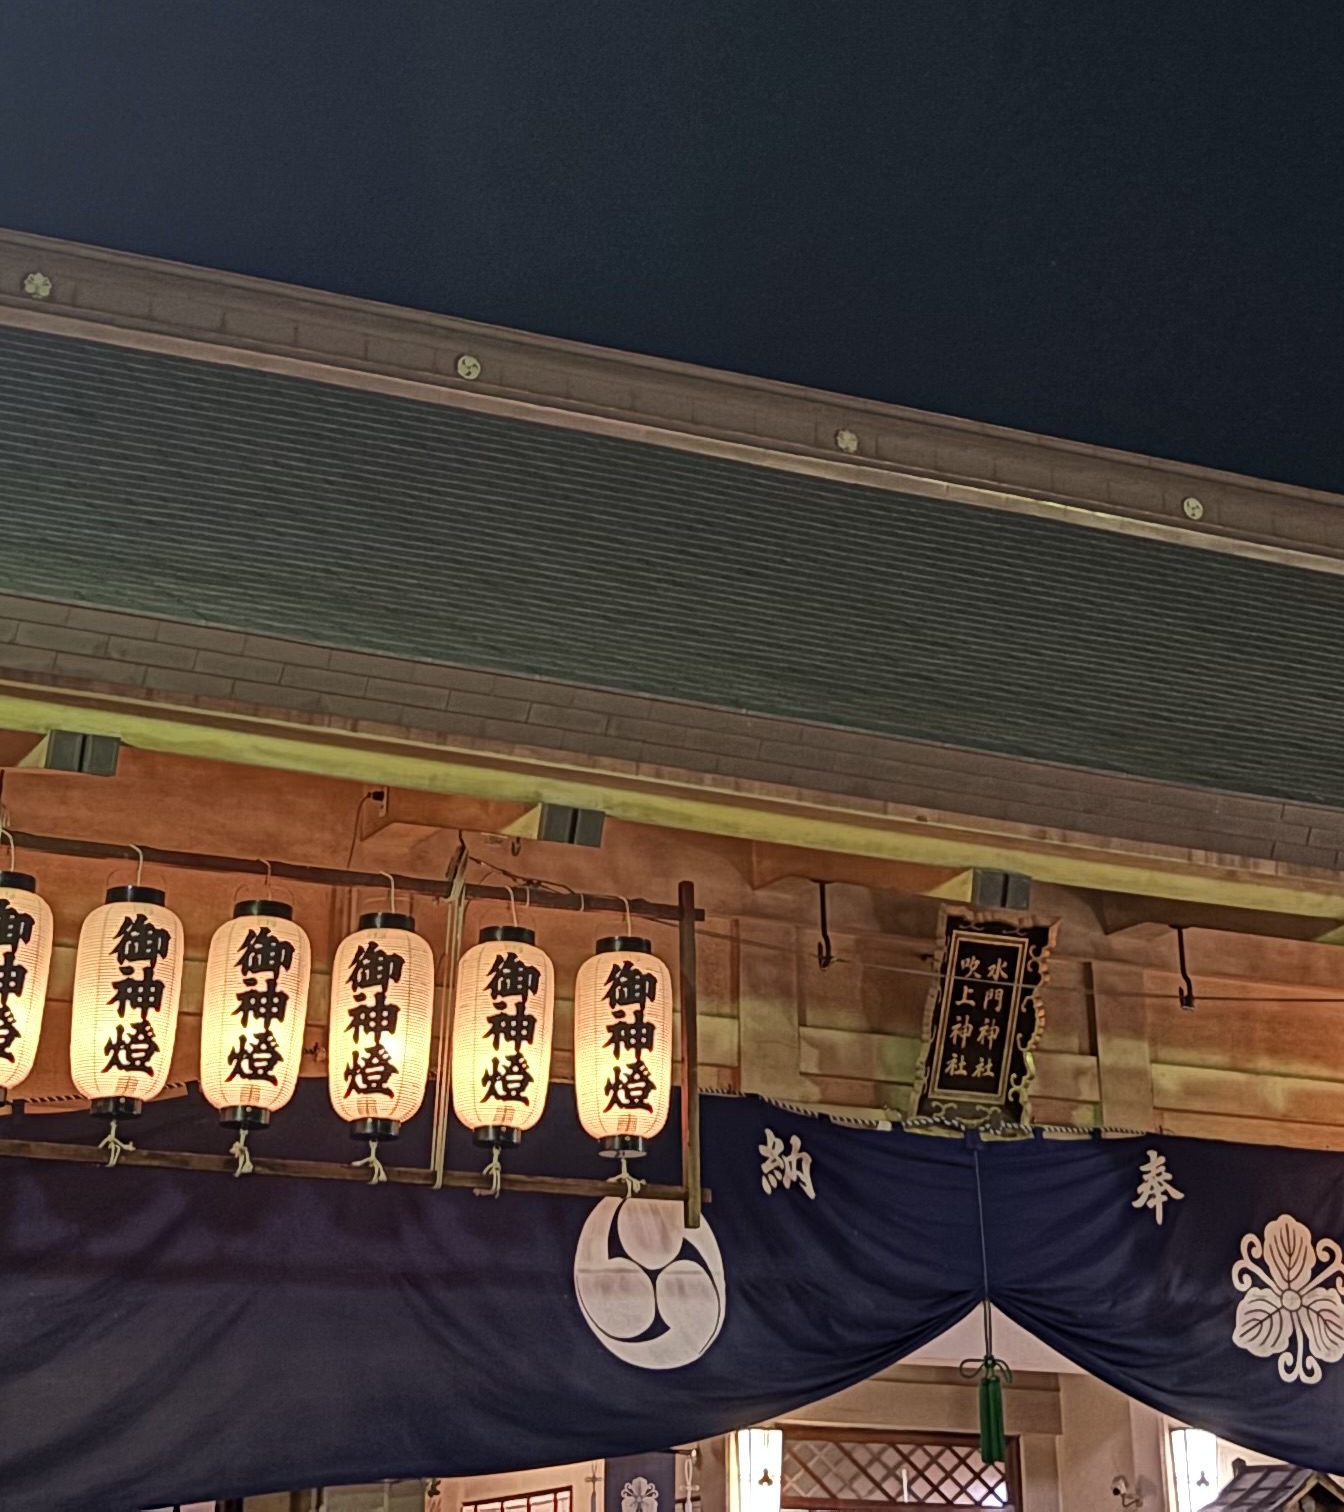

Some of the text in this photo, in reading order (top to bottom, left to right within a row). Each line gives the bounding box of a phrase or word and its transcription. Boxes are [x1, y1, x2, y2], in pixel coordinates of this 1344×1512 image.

[100, 914, 171, 1076] 御神燈
[225, 926, 295, 1085] 御神燈
[343, 940, 405, 1099] 御神燈
[481, 951, 541, 1105] 御神燈
[603, 960, 656, 1113] 御神燈
[945, 955, 982, 1077] 吹上神社
[971, 957, 1009, 1078] 水門神社
[758, 1128, 816, 1200] 納
[1132, 1149, 1184, 1226] 奉
